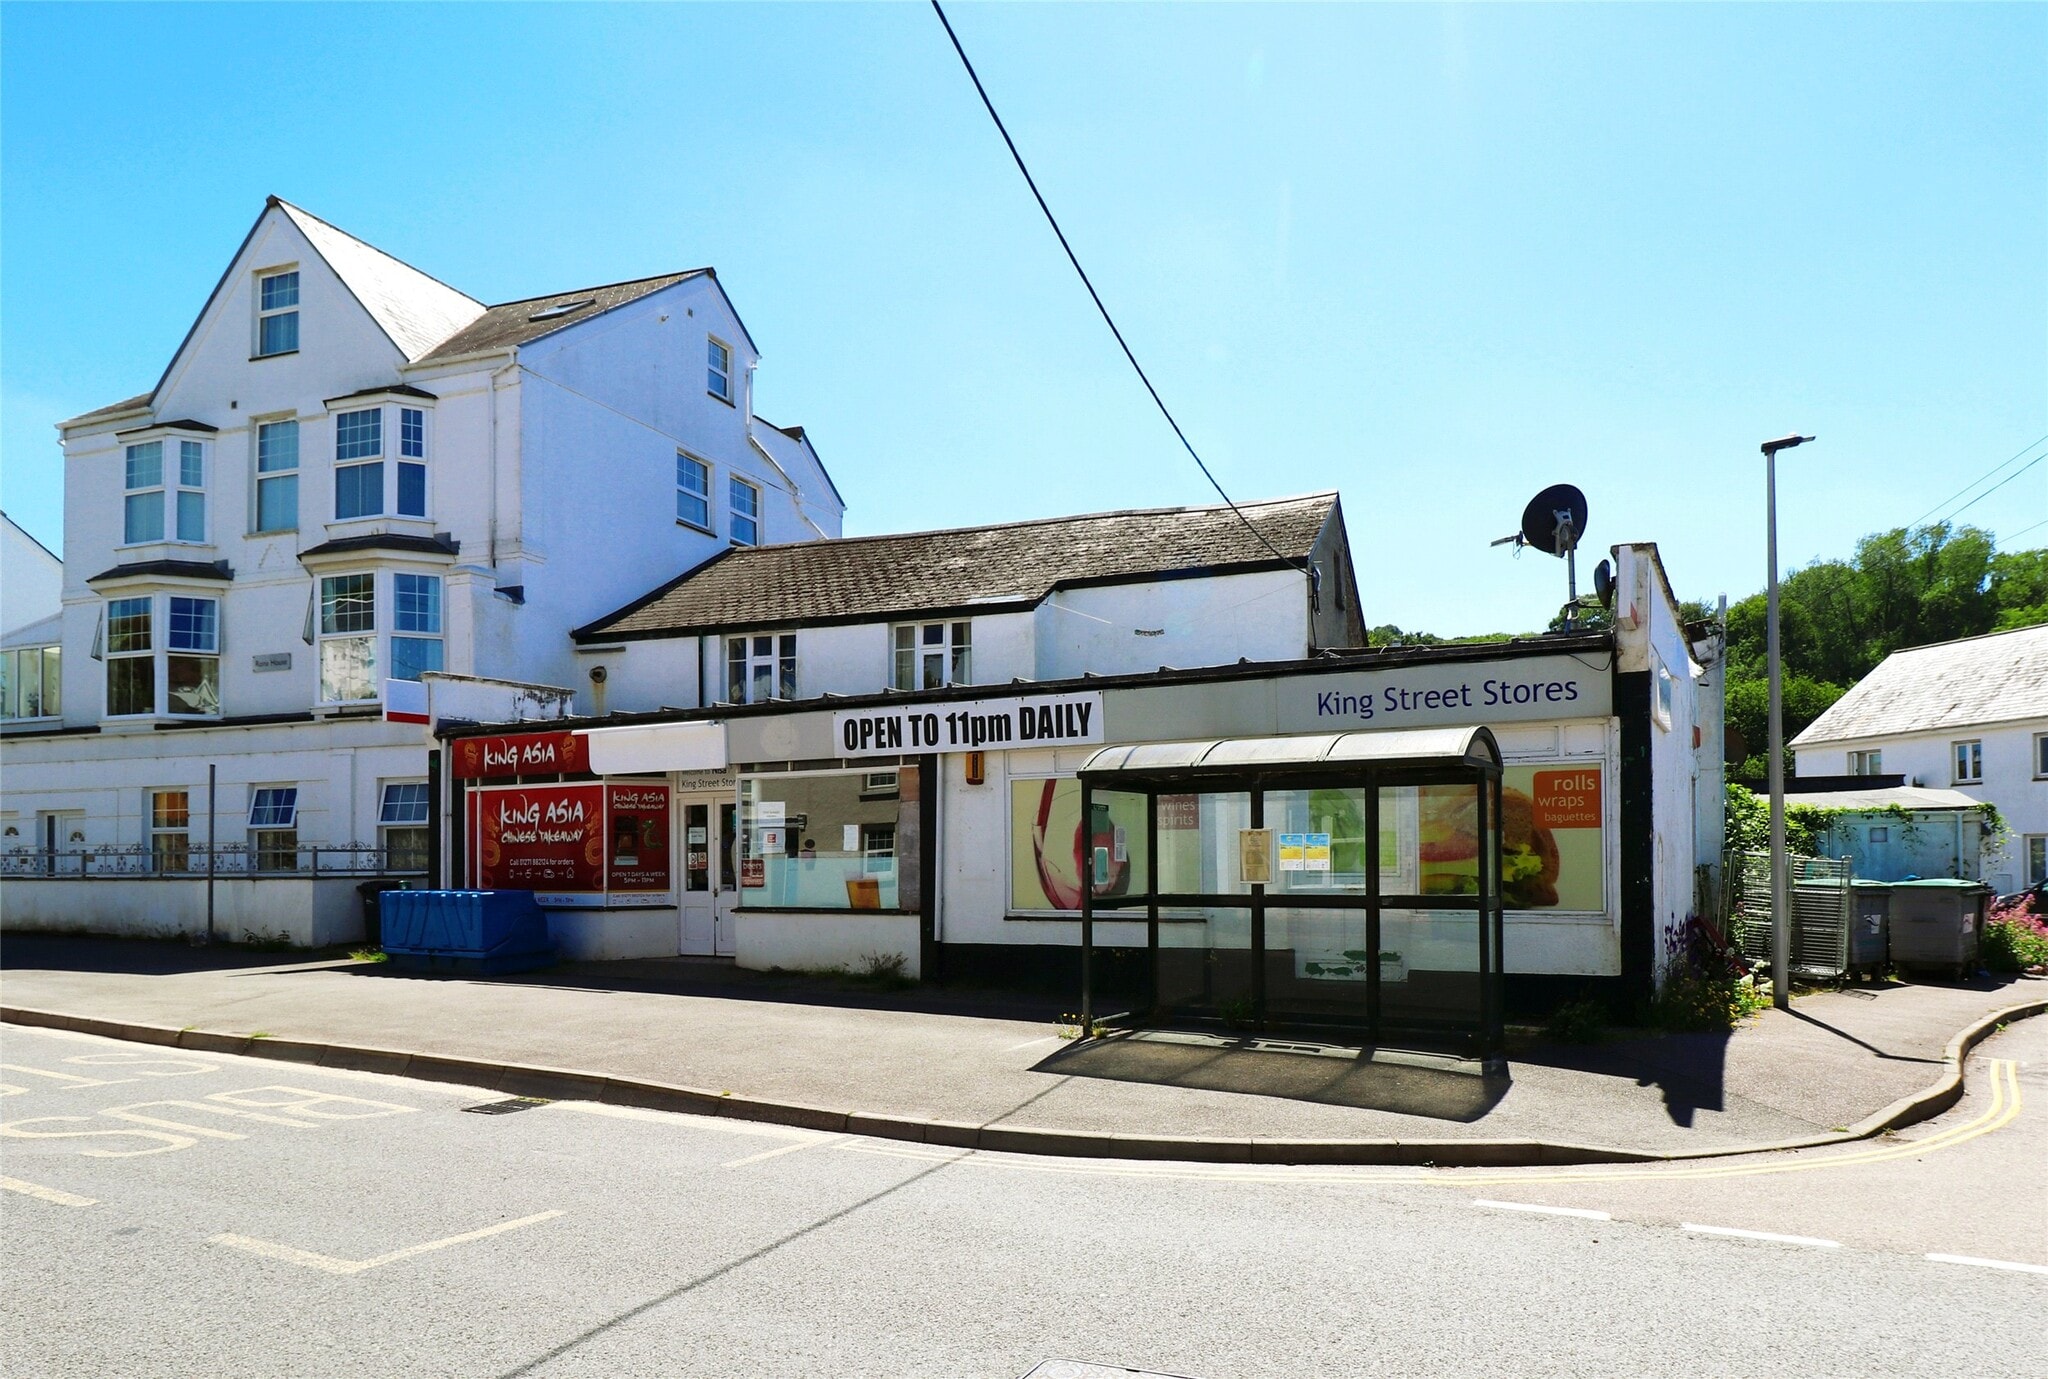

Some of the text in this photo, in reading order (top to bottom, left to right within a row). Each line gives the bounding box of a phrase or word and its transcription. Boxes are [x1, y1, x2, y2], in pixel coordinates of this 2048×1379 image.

[1317, 679, 1579, 719] King Street Stores
[843, 702, 1093, 751] OPEN TO 11pm DAILY
[484, 738, 556, 772] KING ASIA
[681, 779, 697, 790] King
[698, 778, 721, 788] Street
[1553, 774, 1596, 791] rolls
[613, 788, 665, 804] KING ASIA
[1538, 796, 1585, 810] wraps
[500, 794, 585, 832] KING ASIA
[1161, 800, 1196, 811] wines
[1157, 813, 1194, 826] spirits
[1544, 812, 1596, 824] baguettes
[501, 828, 584, 846] CHINESE TAKEAWAY
[509, 858, 519, 866] Call
[549, 858, 557, 866] for
[557, 858, 574, 866] orders
[0, 1085, 421, 1158] BUS
